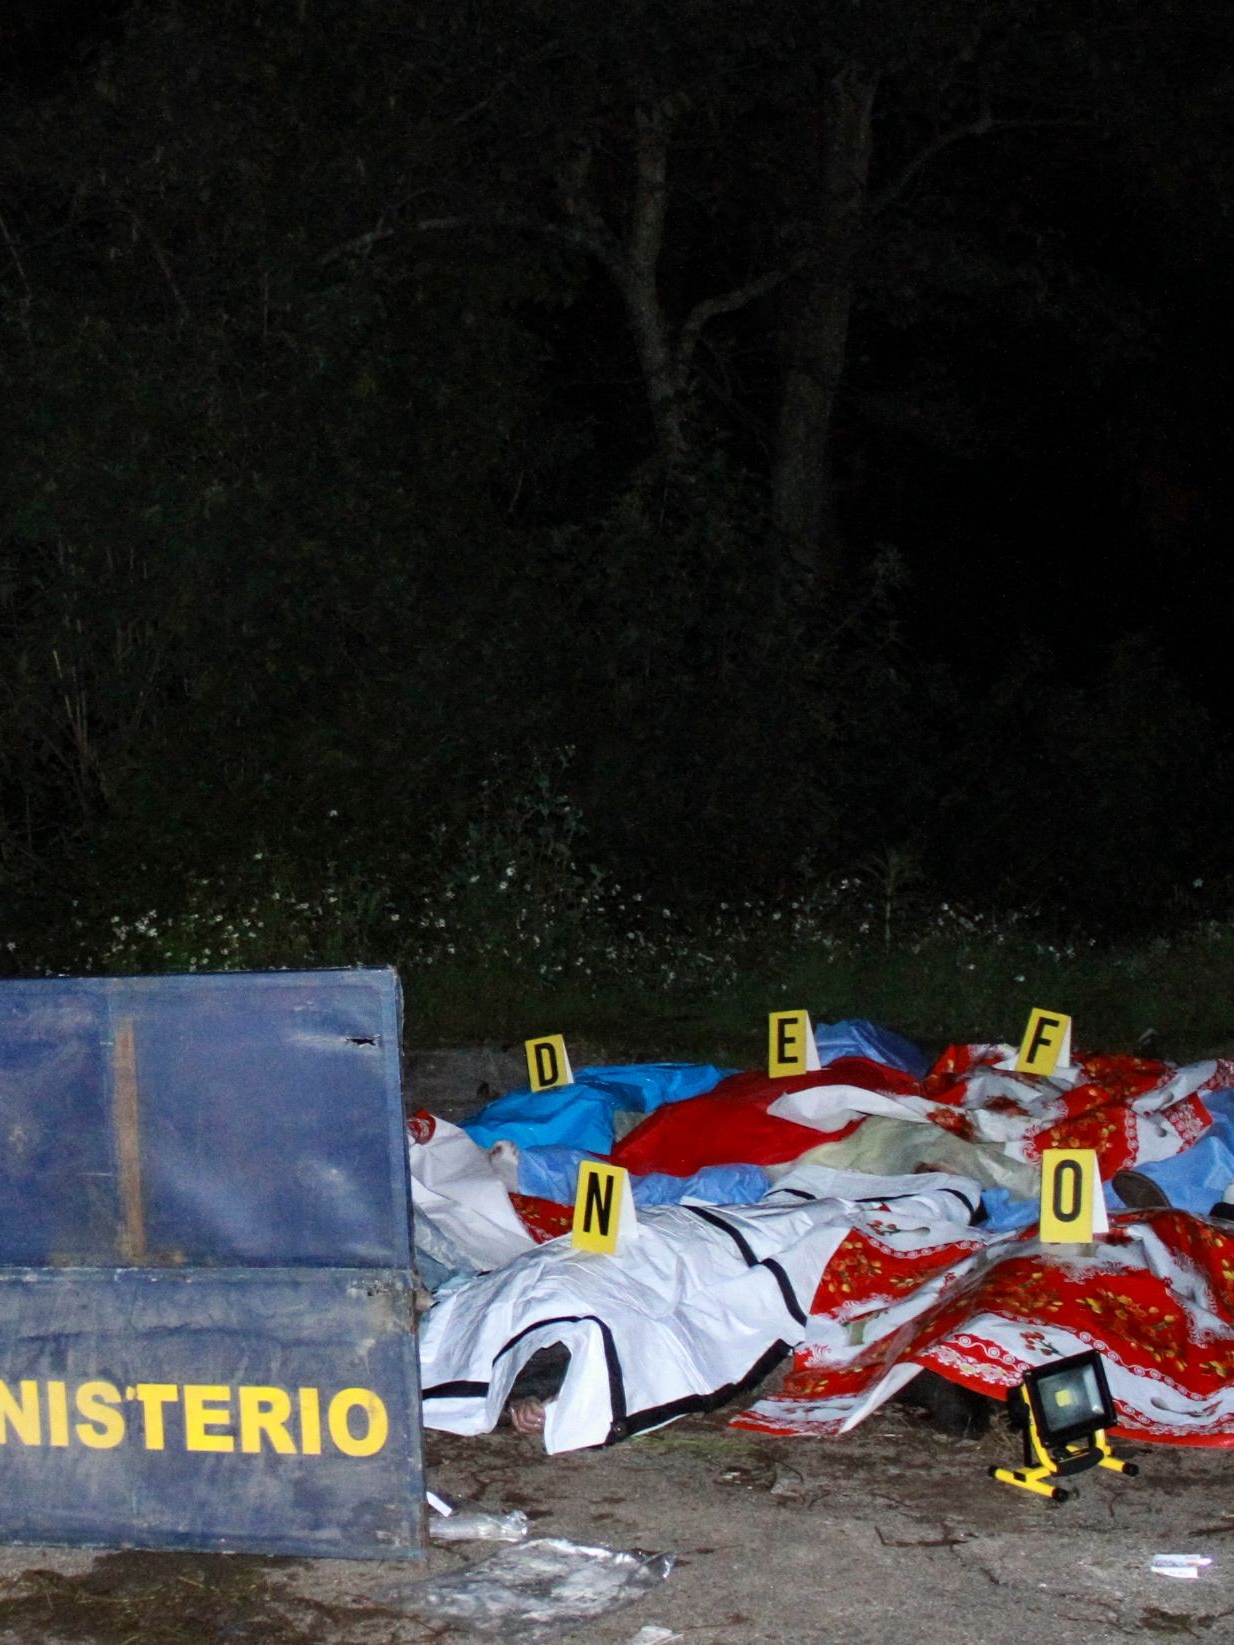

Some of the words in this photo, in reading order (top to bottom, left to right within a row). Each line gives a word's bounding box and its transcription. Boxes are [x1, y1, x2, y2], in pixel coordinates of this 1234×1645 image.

[777, 1017, 799, 1064] E
[1026, 1017, 1060, 1065] F
[534, 1042, 559, 1087] D
[583, 1171, 615, 1236] N
